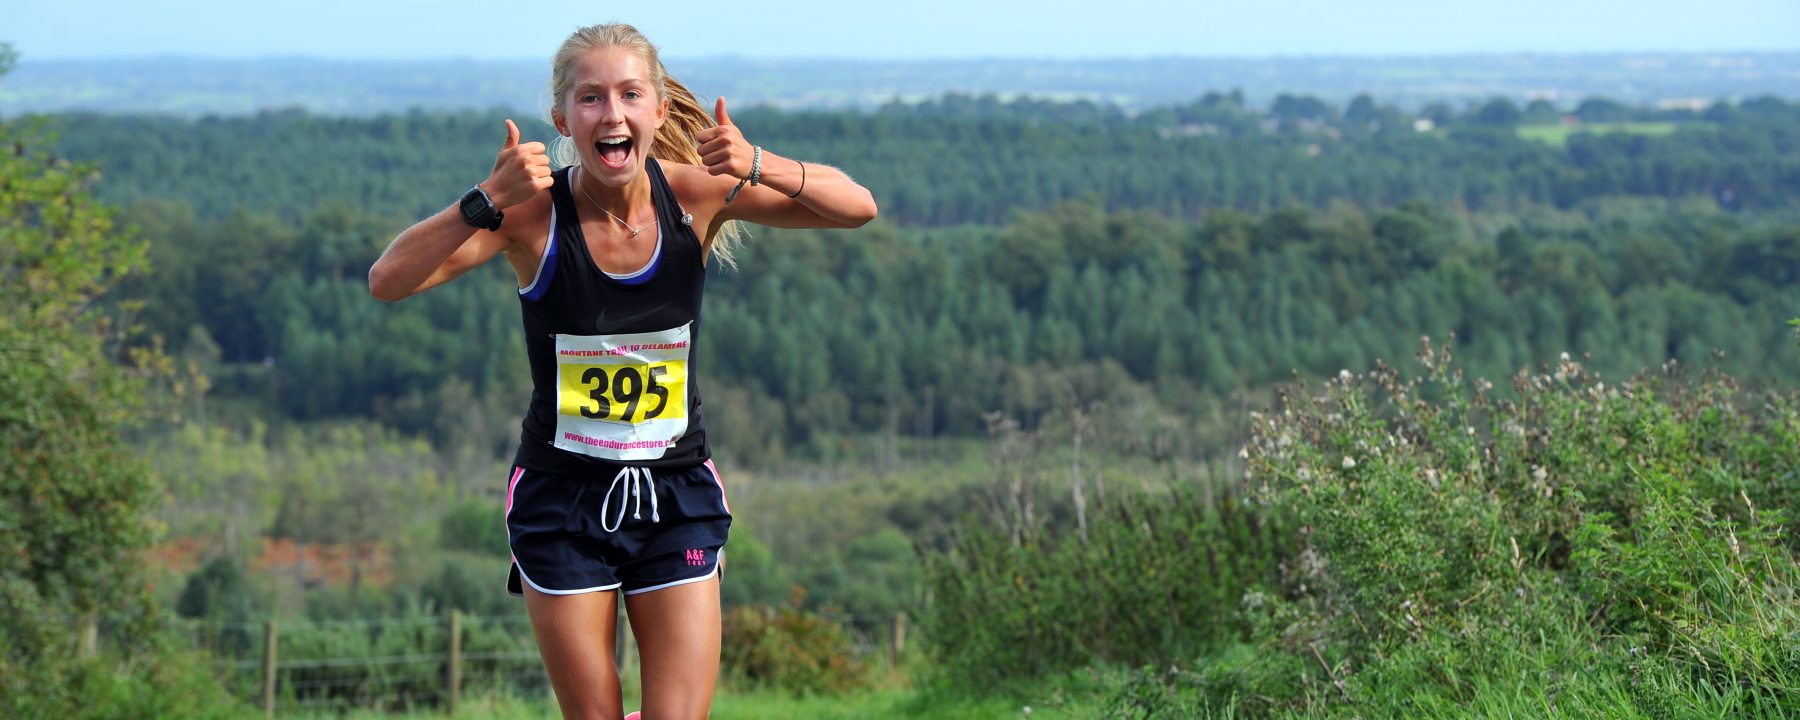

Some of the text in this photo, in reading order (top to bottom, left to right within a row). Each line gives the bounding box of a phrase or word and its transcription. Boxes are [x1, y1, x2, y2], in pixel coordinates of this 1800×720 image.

[560, 349, 604, 357] MONTANE
[606, 345, 628, 357] TRAIL
[641, 340, 687, 350] DELAMERE
[579, 366, 669, 422] 395
[564, 431, 672, 450] www.theendurancestore.c
[686, 549, 704, 560] A&F
